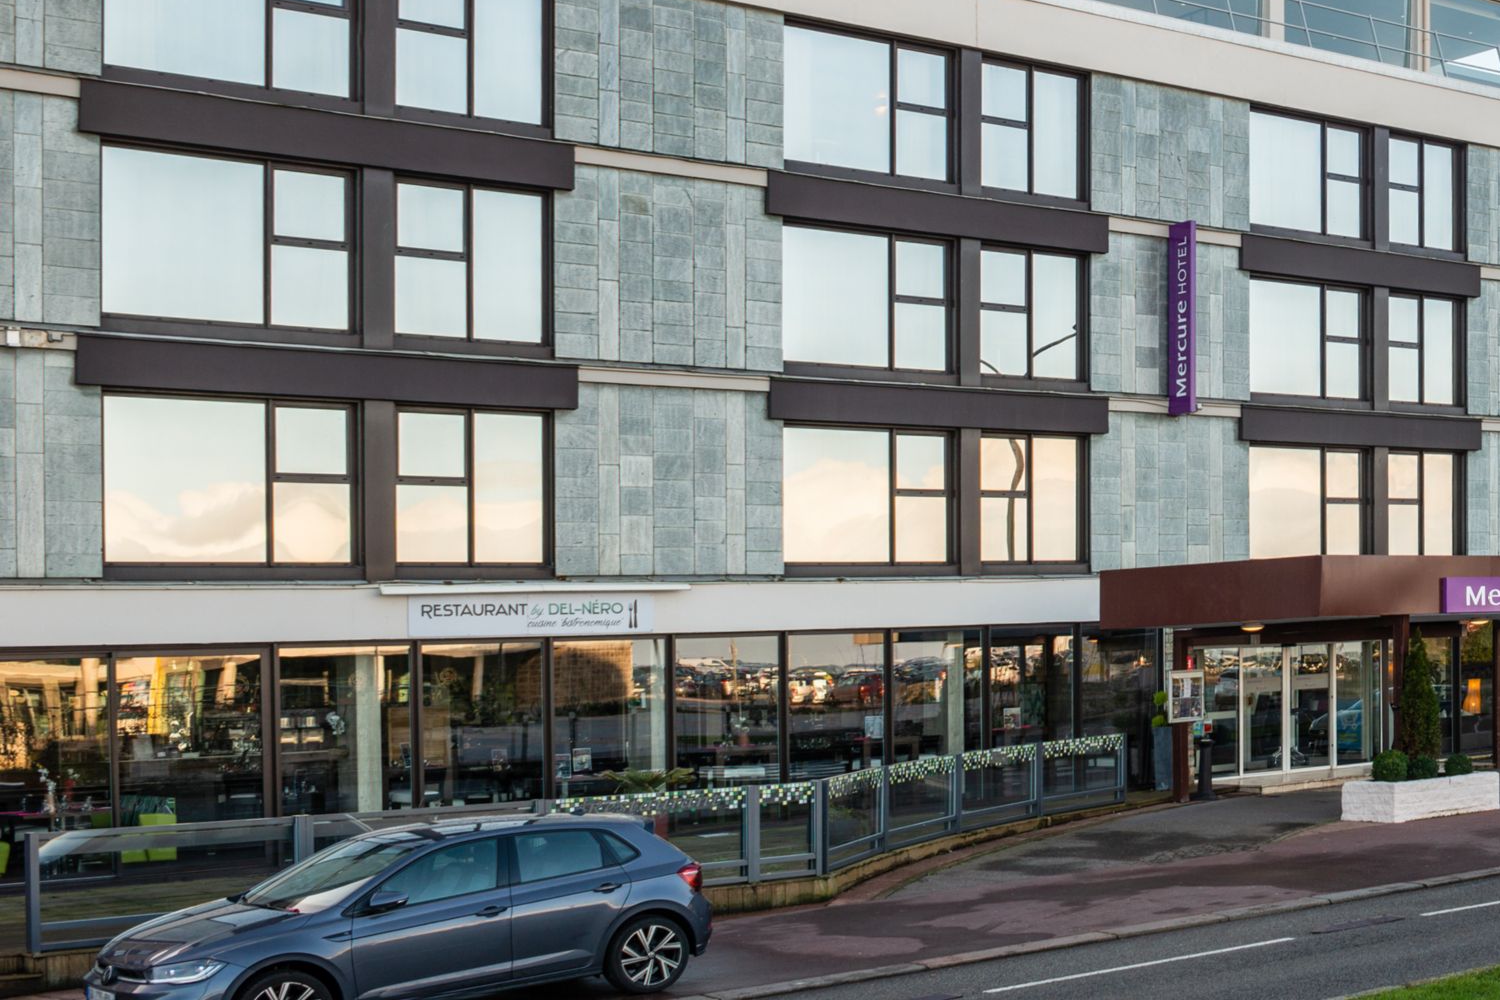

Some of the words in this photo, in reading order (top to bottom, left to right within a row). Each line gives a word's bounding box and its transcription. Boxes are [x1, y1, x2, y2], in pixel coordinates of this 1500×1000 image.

[1177, 235, 1188, 295] HOTEL
[1176, 300, 1188, 399] Mercure
[421, 603, 528, 619] RESTAURANT
[529, 603, 545, 619] by
[548, 599, 625, 616] DEL-NÉRO
